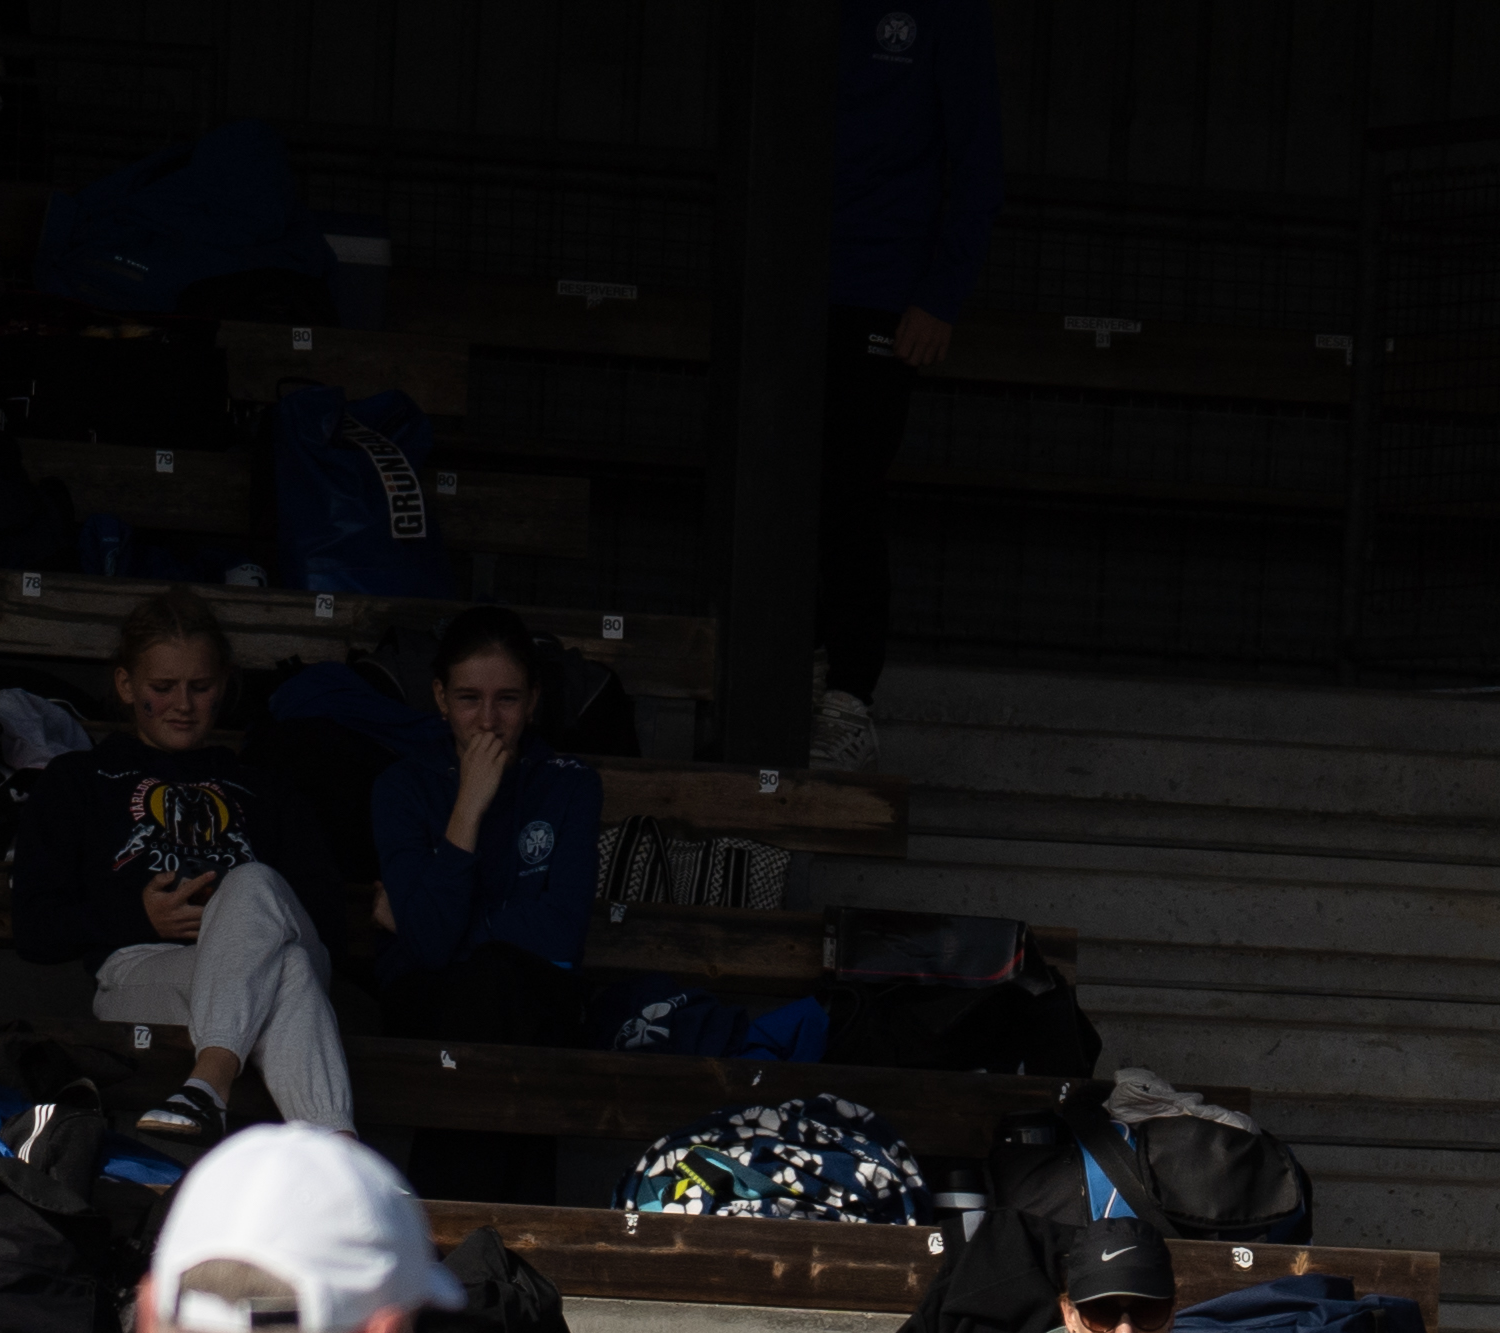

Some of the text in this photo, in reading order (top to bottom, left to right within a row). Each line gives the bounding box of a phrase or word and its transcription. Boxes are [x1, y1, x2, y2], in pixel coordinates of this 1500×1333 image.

[559, 283, 636, 298] RESERVERET
[1066, 317, 1140, 331] RESERVERET
[292, 330, 311, 343] 80
[155, 452, 174, 465] 79
[437, 474, 456, 488] 80
[24, 576, 42, 590] 78
[316, 597, 333, 609] 79
[603, 618, 622, 631] 80
[759, 772, 779, 787] 80
[134, 1027, 152, 1042] 77
